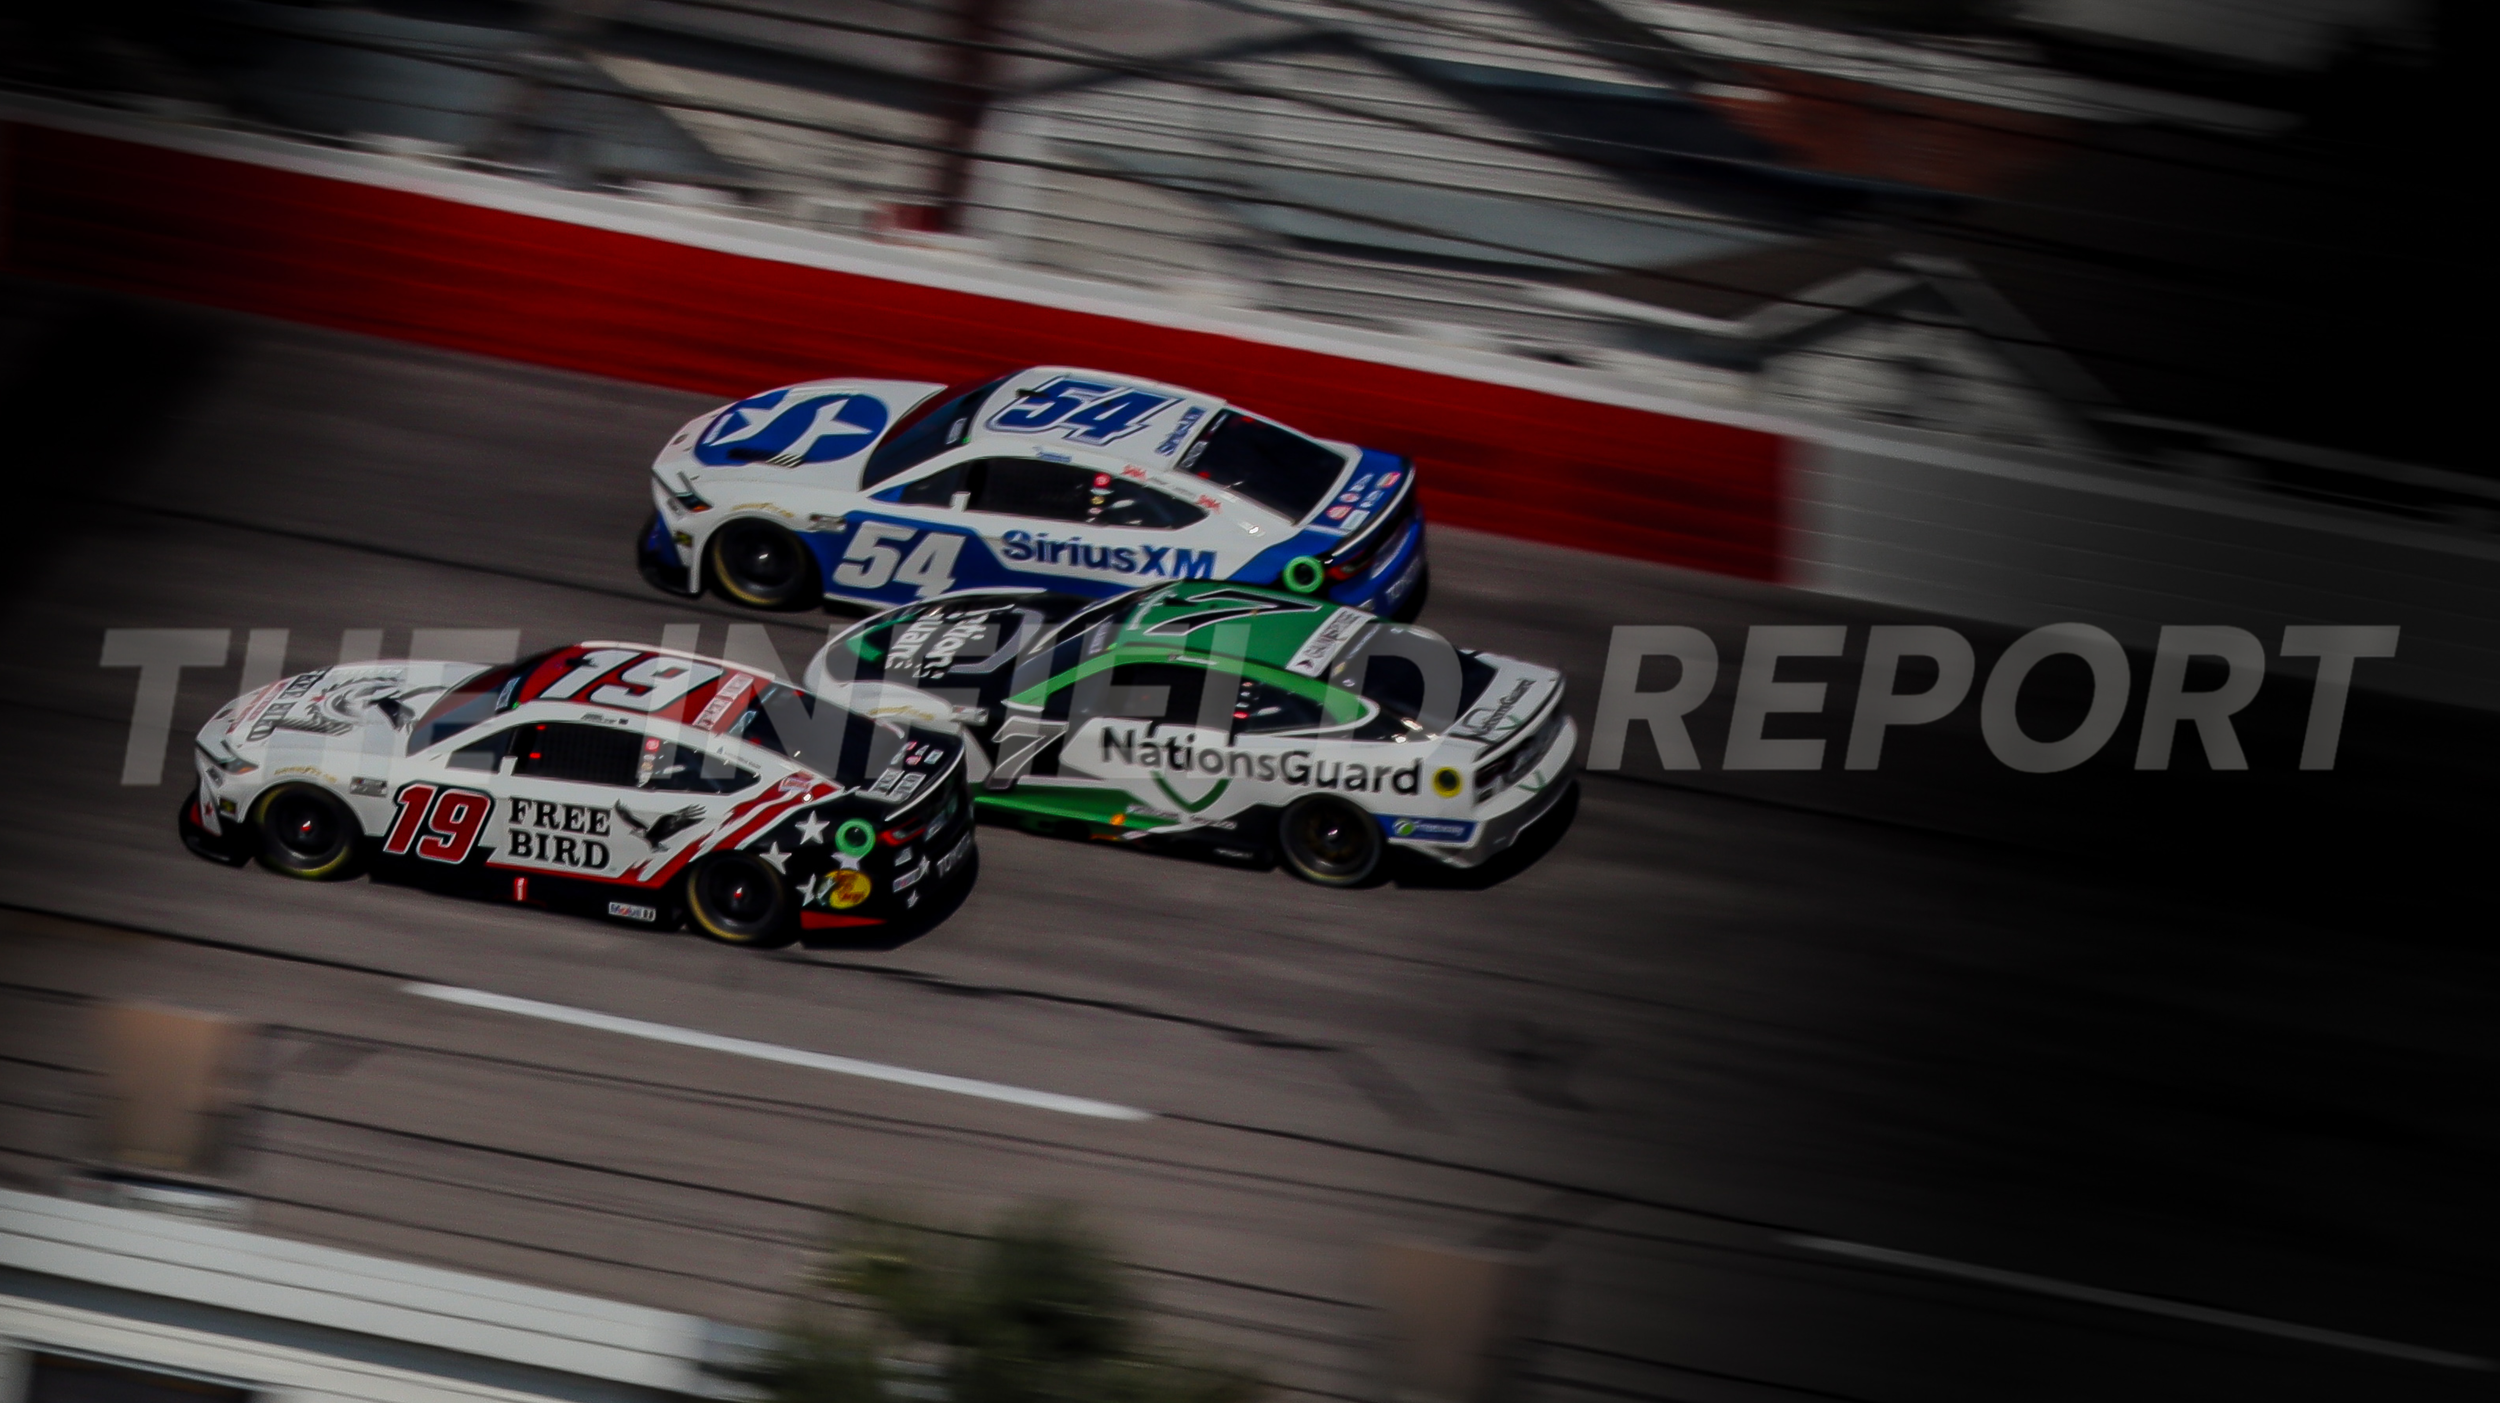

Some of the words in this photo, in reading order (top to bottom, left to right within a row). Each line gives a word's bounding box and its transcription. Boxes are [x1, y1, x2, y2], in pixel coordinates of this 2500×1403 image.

[984, 376, 1185, 446] 54
[833, 521, 966, 599] 54
[1002, 530, 1216, 580] SiriusXM
[1143, 588, 1323, 636] 7
[539, 649, 725, 712] 19
[984, 715, 1069, 790] 7
[1101, 725, 1423, 795] NationsGuard
[383, 782, 494, 864] 19
[508, 828, 610, 870] BIRD
[509, 796, 611, 837] FREE
